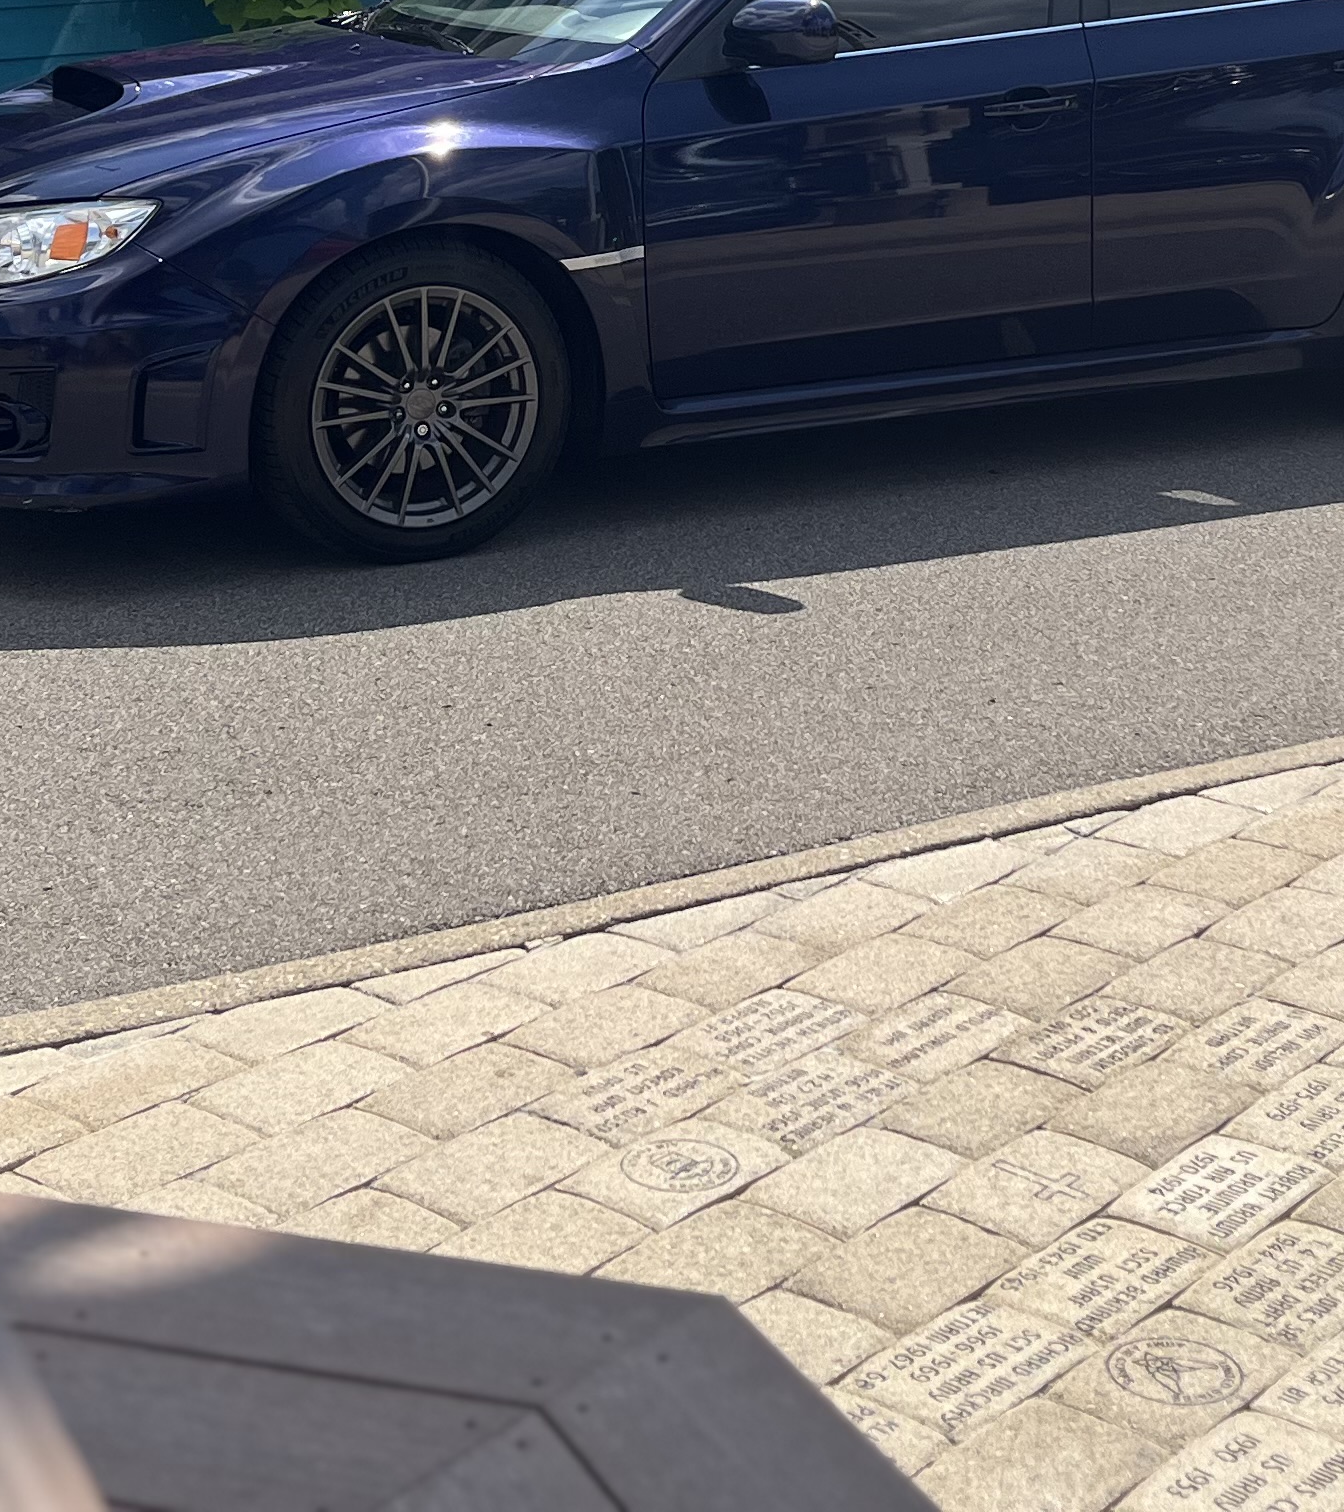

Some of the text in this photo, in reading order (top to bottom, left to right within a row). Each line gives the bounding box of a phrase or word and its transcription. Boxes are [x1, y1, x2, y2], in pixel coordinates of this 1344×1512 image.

[1297, 1105, 1342, 1131] NAVY
[1156, 1150, 1259, 1217] US AIR FORCE
[1206, 1164, 1316, 1239] ROBERT BROWN
[1065, 1247, 1159, 1308] SSGT USAAF
[1231, 1275, 1282, 1309] ARMY
[1073, 1285, 1147, 1334] BERNARD
[1251, 1293, 1302, 1328] DRAFT
[1295, 1292, 1342, 1325] JONES
[926, 1329, 1042, 1403] SGT US ARMY
[1010, 1332, 1084, 1377] RICHARD
[1211, 1453, 1295, 1512] US ARMY
